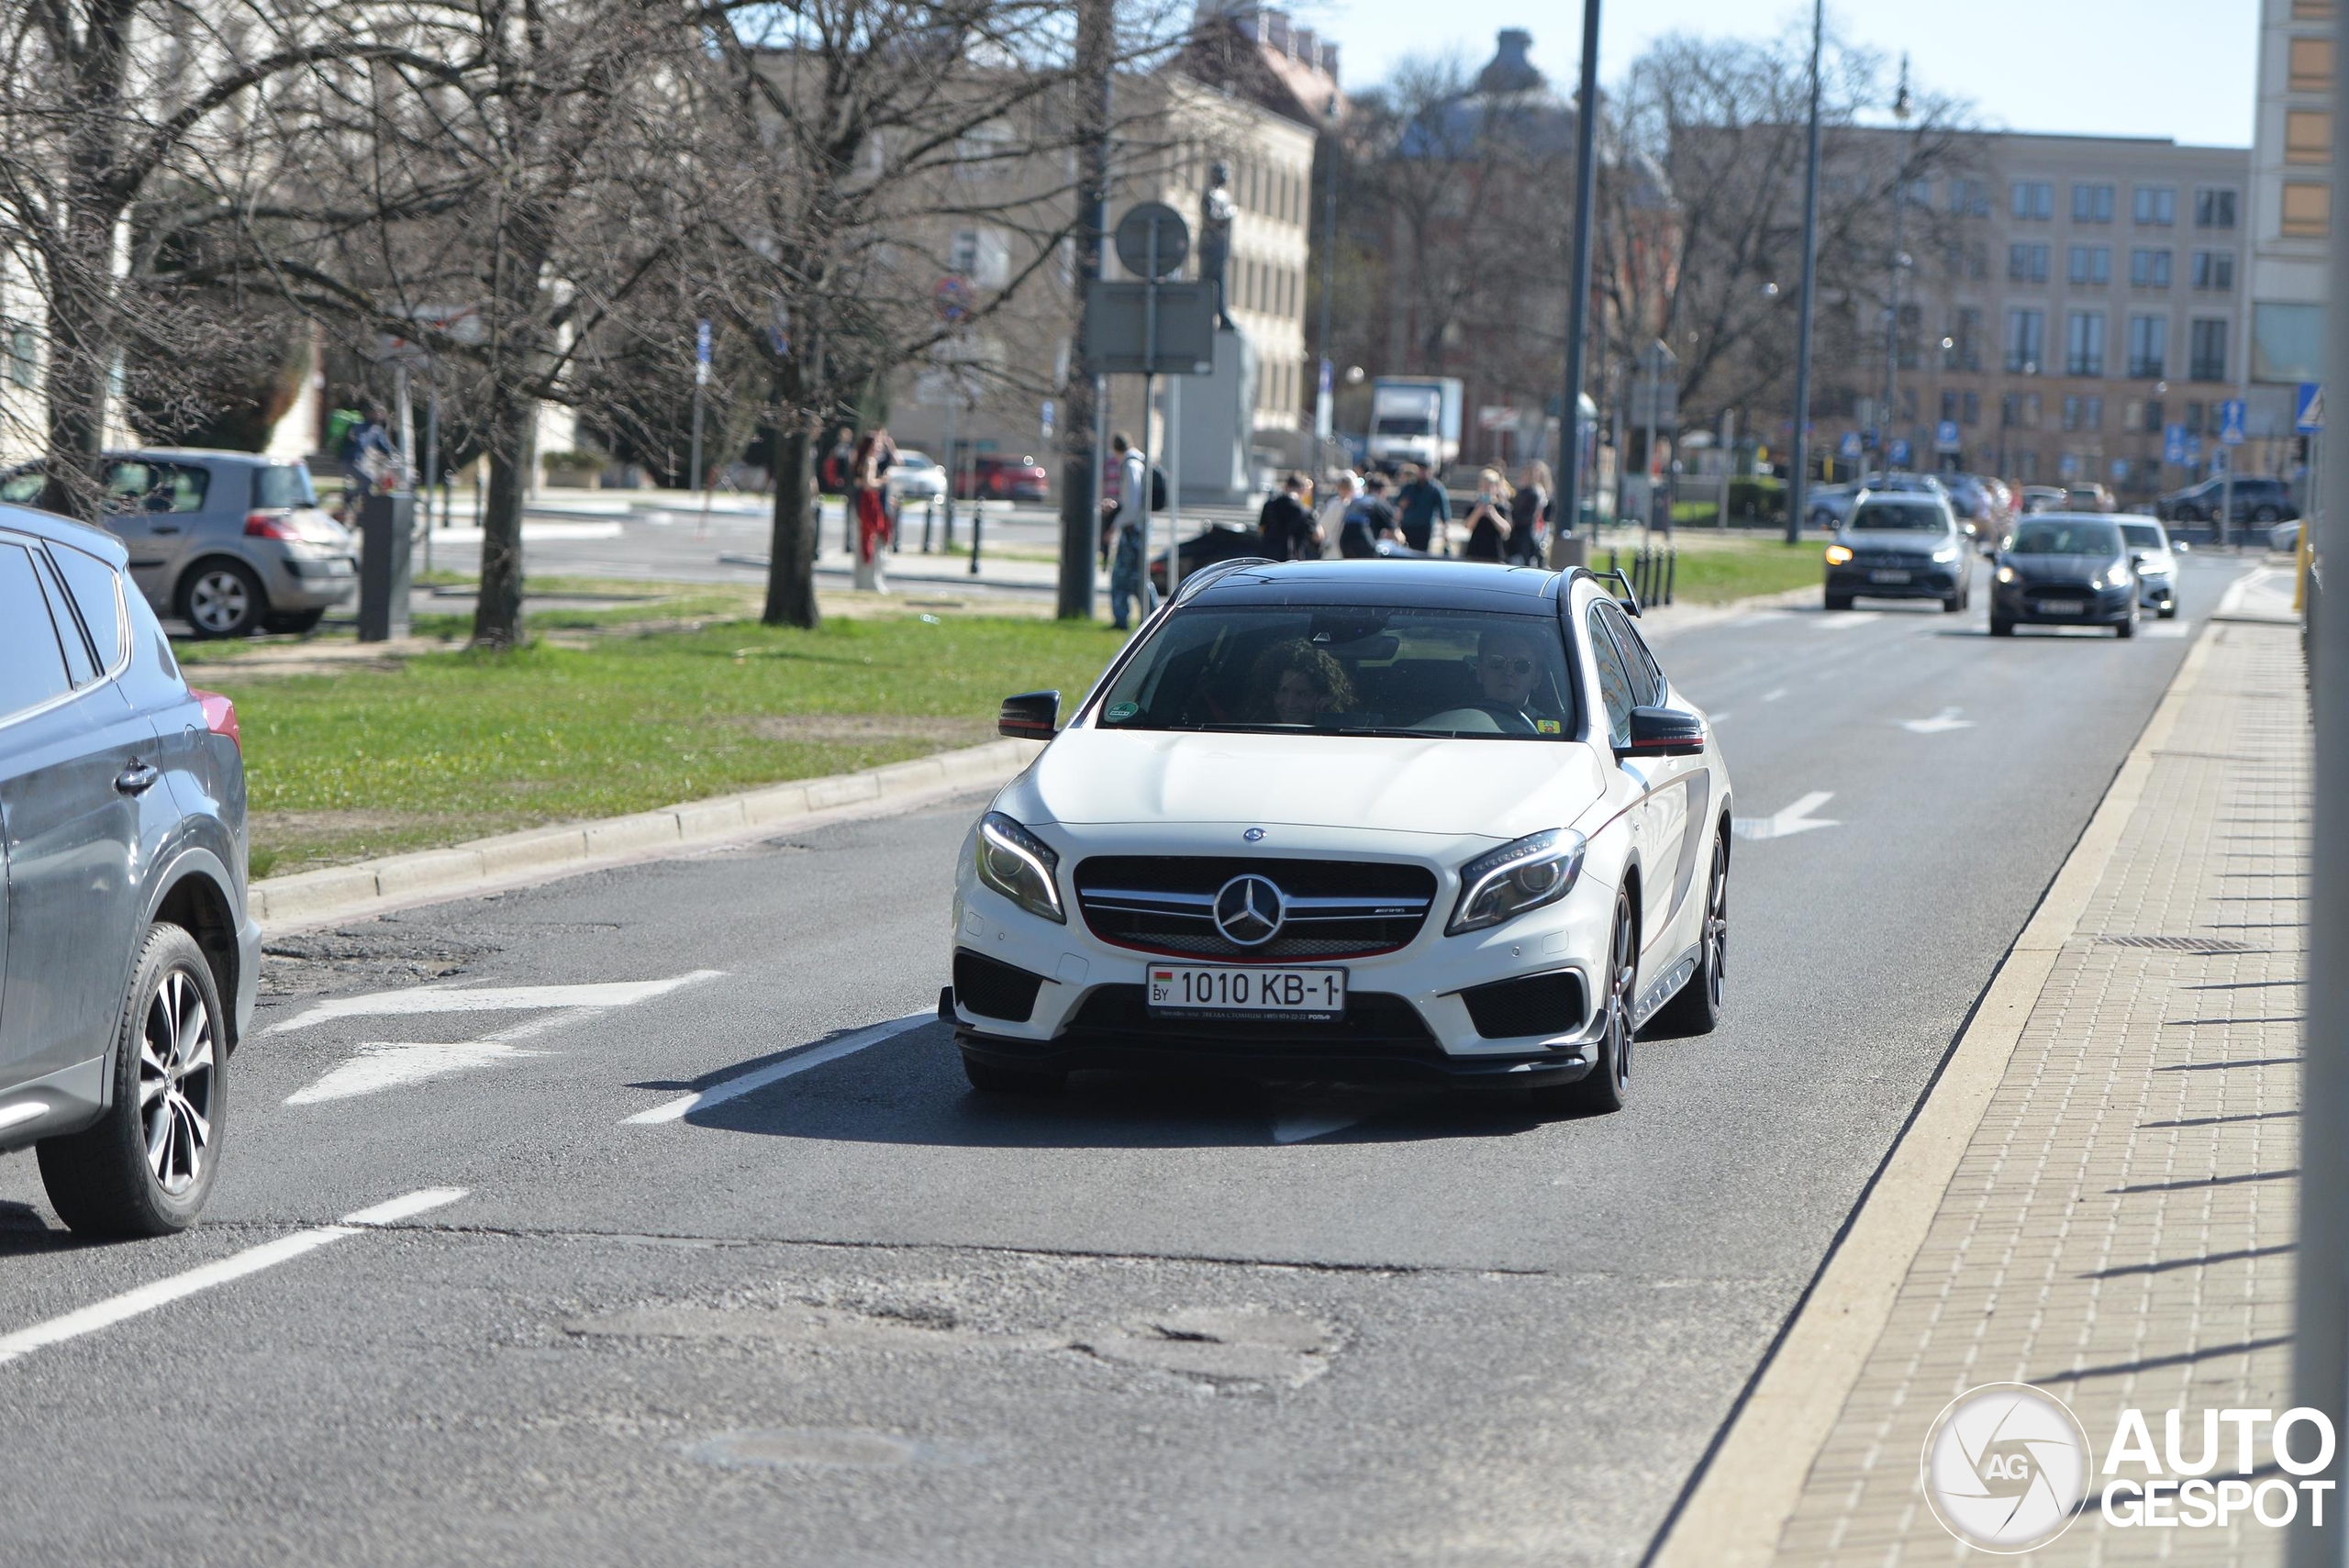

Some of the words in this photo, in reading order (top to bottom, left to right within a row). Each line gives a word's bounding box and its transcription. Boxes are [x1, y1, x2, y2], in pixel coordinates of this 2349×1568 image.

[1153, 989, 1169, 1001] BY
[1182, 972, 1249, 1003] 1010
[1262, 973, 1333, 1006] KB-1
